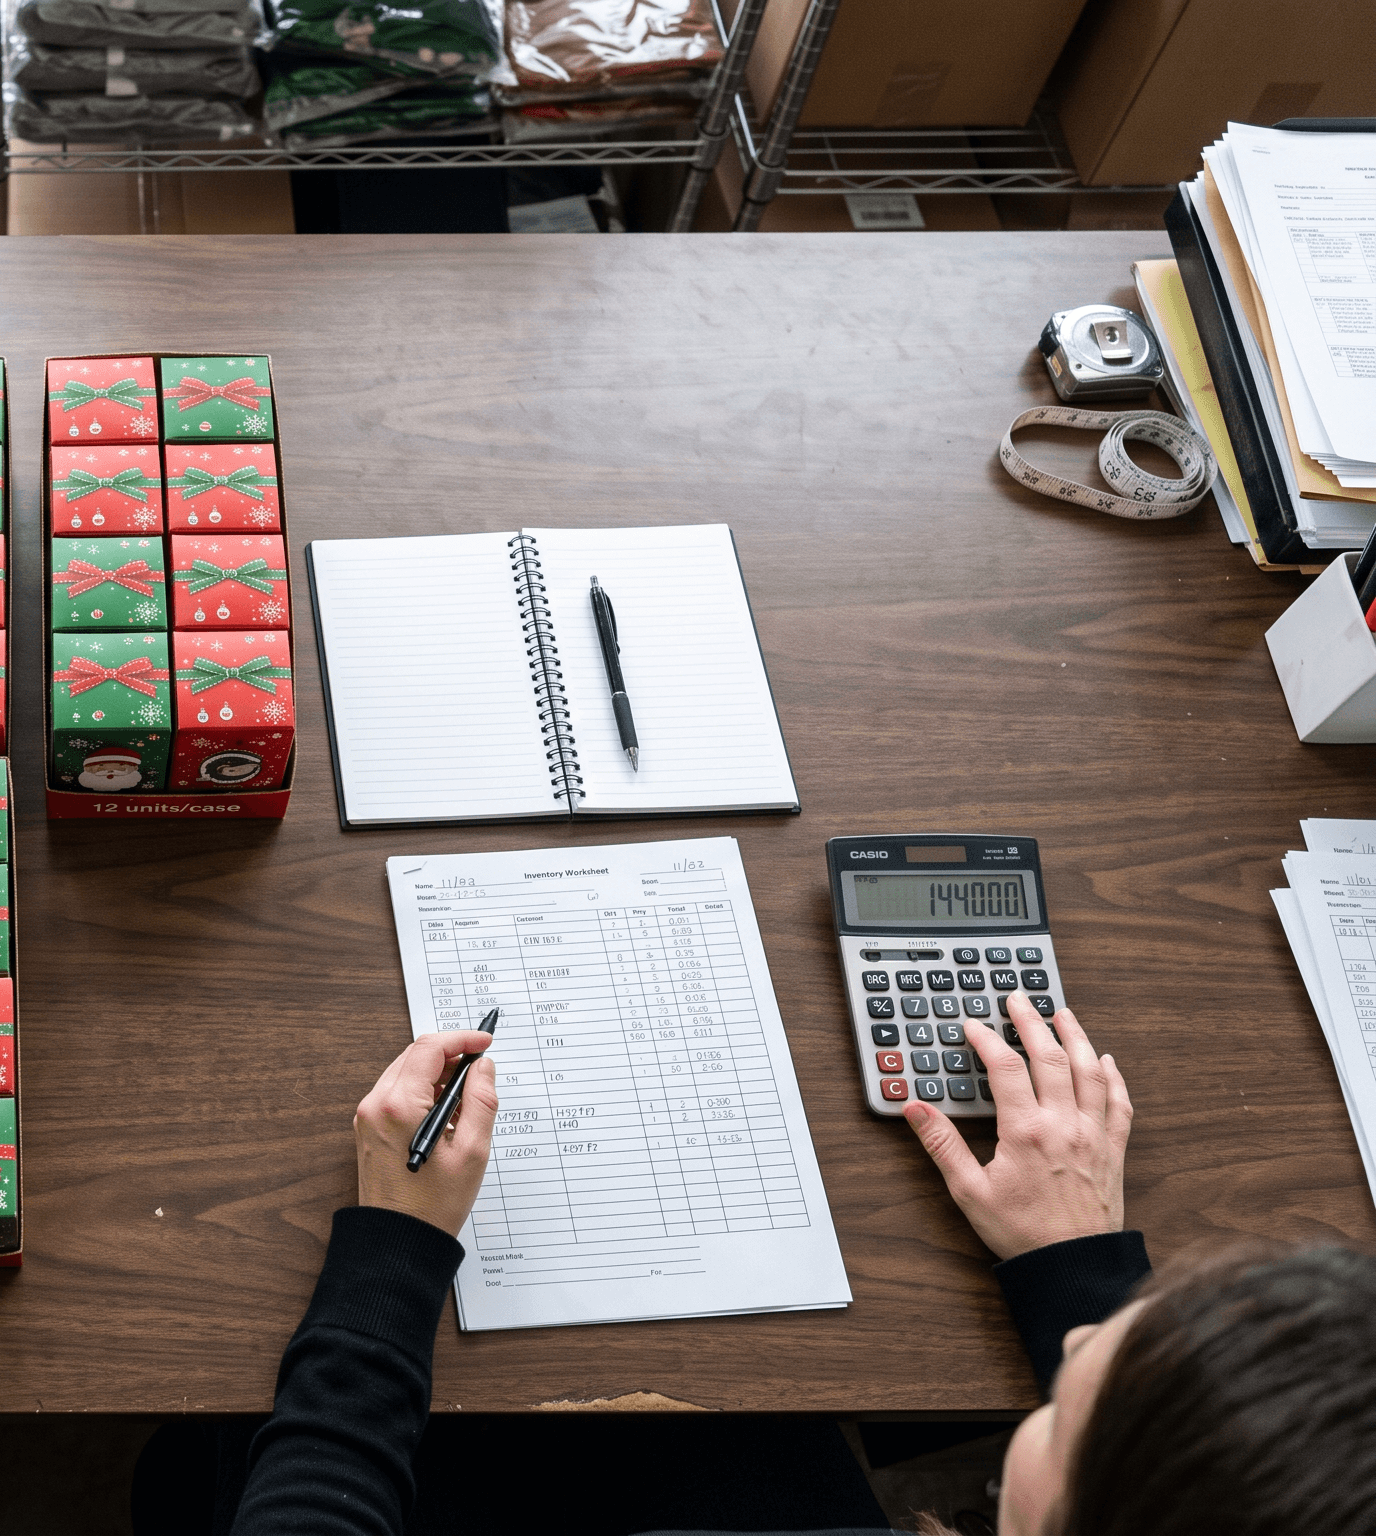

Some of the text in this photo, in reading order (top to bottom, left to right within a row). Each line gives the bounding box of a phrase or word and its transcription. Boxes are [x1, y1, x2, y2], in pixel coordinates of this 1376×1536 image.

[93, 803, 241, 813] 12 units/case
[850, 850, 889, 859] CASIO
[524, 867, 609, 880] Inventory Worksheet
[996, 973, 1015, 984] MC
[910, 1000, 921, 1012] 7
[942, 999, 953, 1012] 8
[972, 999, 984, 1012] 9
[916, 1026, 928, 1039] 4
[948, 1026, 959, 1040] 5
[884, 1055, 897, 1067] C
[922, 1054, 930, 1067] 1
[953, 1054, 964, 1067] 2
[889, 1082, 902, 1095] C
[926, 1081, 938, 1096] 0
